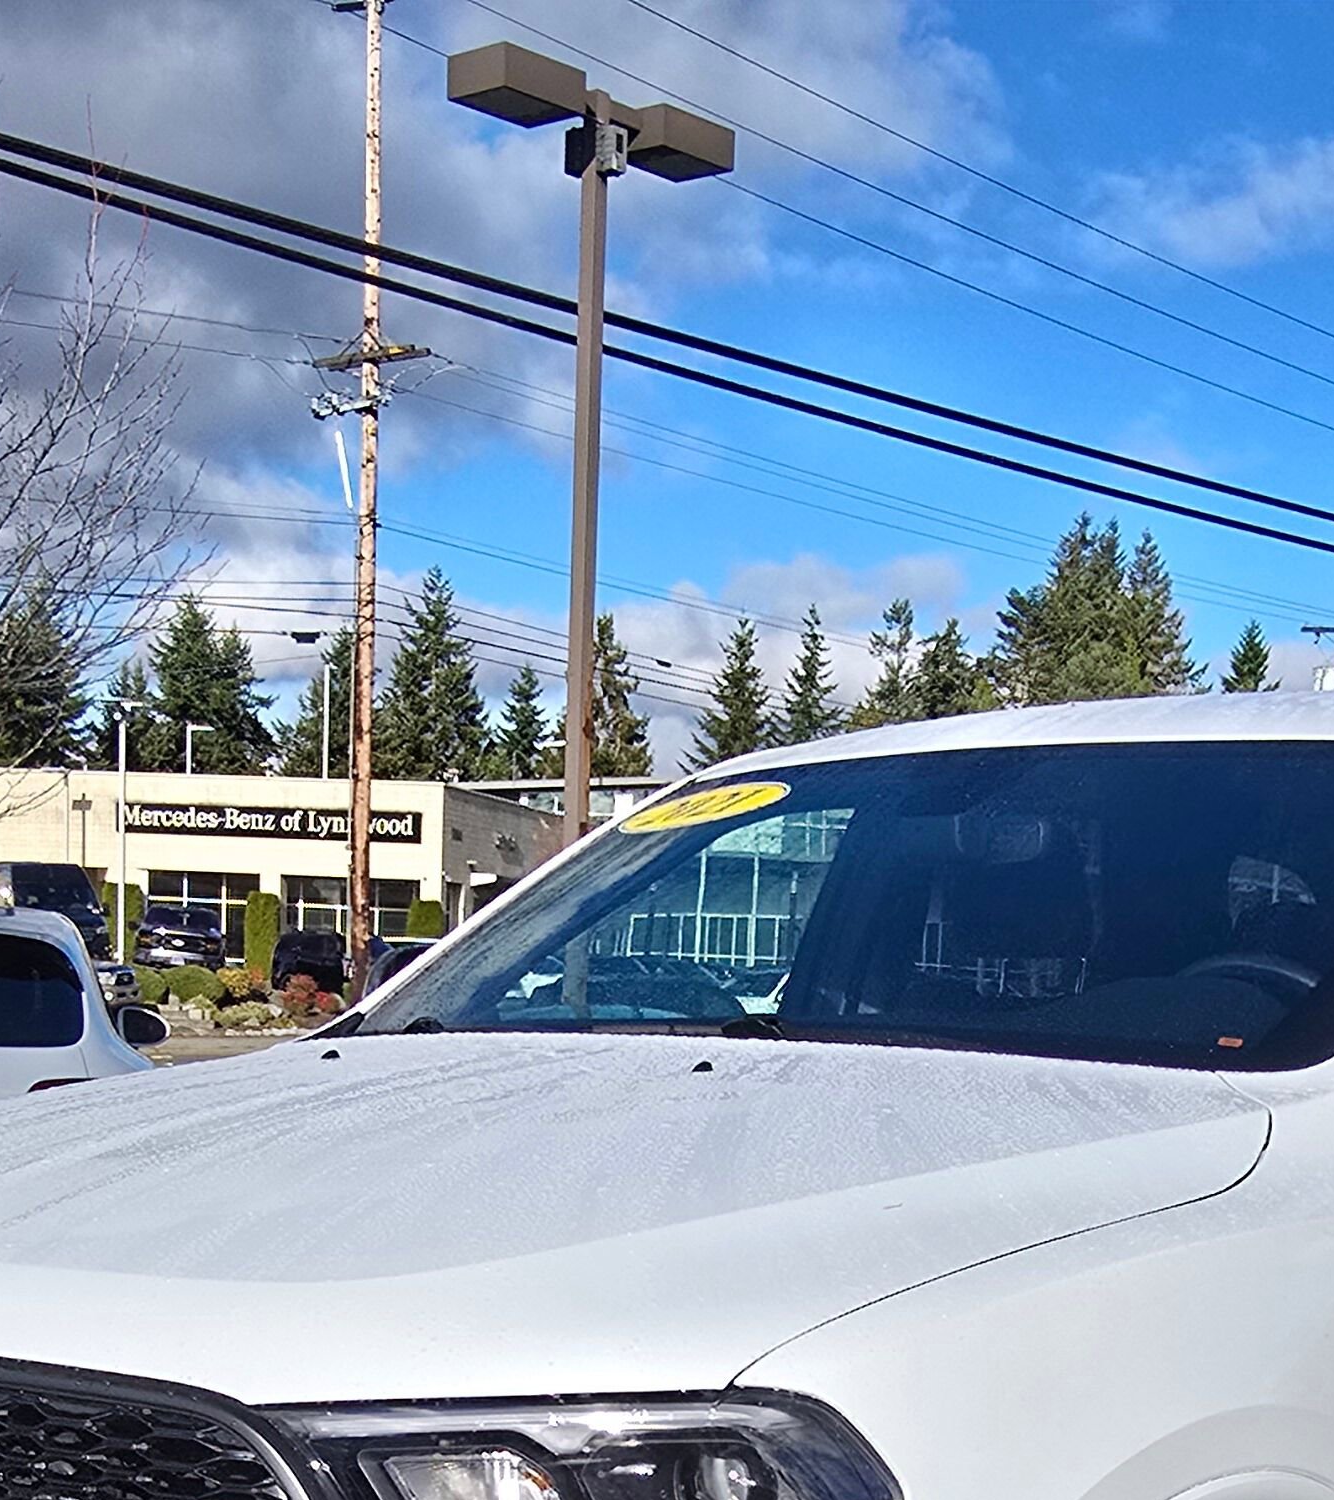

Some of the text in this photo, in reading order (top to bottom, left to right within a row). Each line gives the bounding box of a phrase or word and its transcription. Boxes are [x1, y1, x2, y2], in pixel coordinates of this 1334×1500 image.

[124, 804, 414, 838] Mercedes-Benz of Lynood
